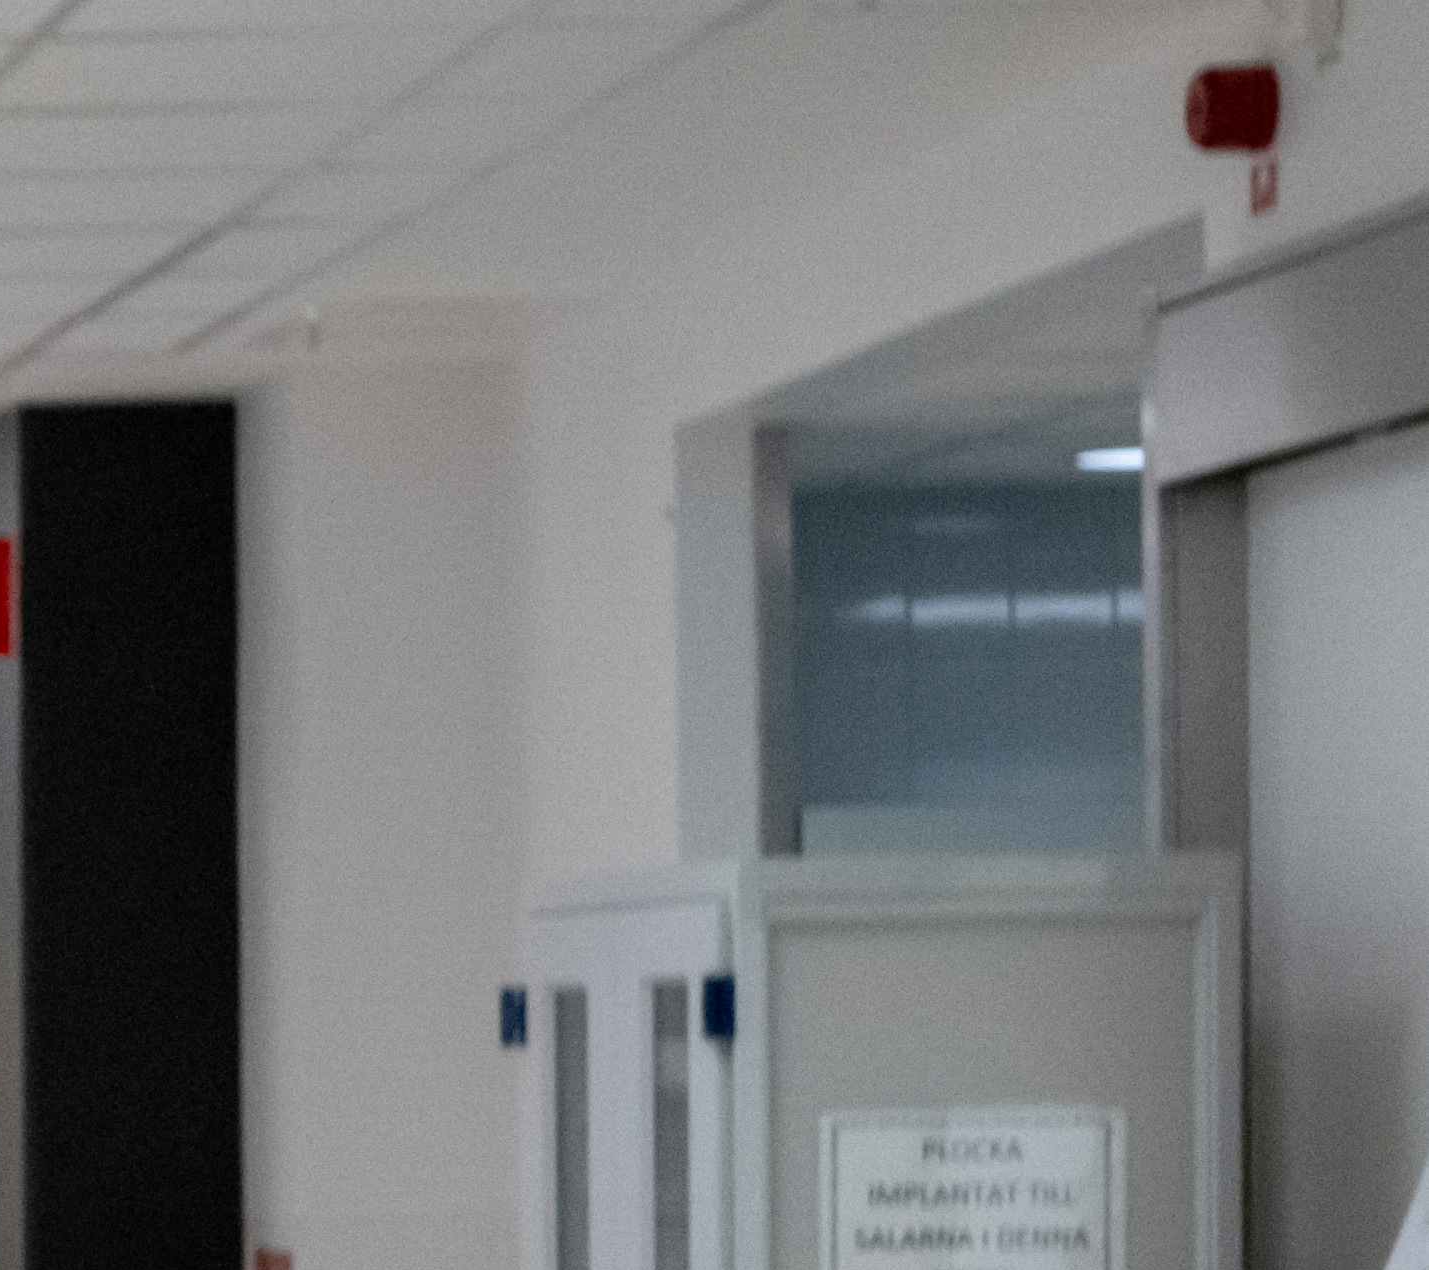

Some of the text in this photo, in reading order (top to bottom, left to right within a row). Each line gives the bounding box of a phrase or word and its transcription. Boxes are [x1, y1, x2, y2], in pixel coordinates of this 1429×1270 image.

[867, 1182, 1072, 1205] IMPLANTAT TILL
[996, 1227, 1090, 1251] DENNA
